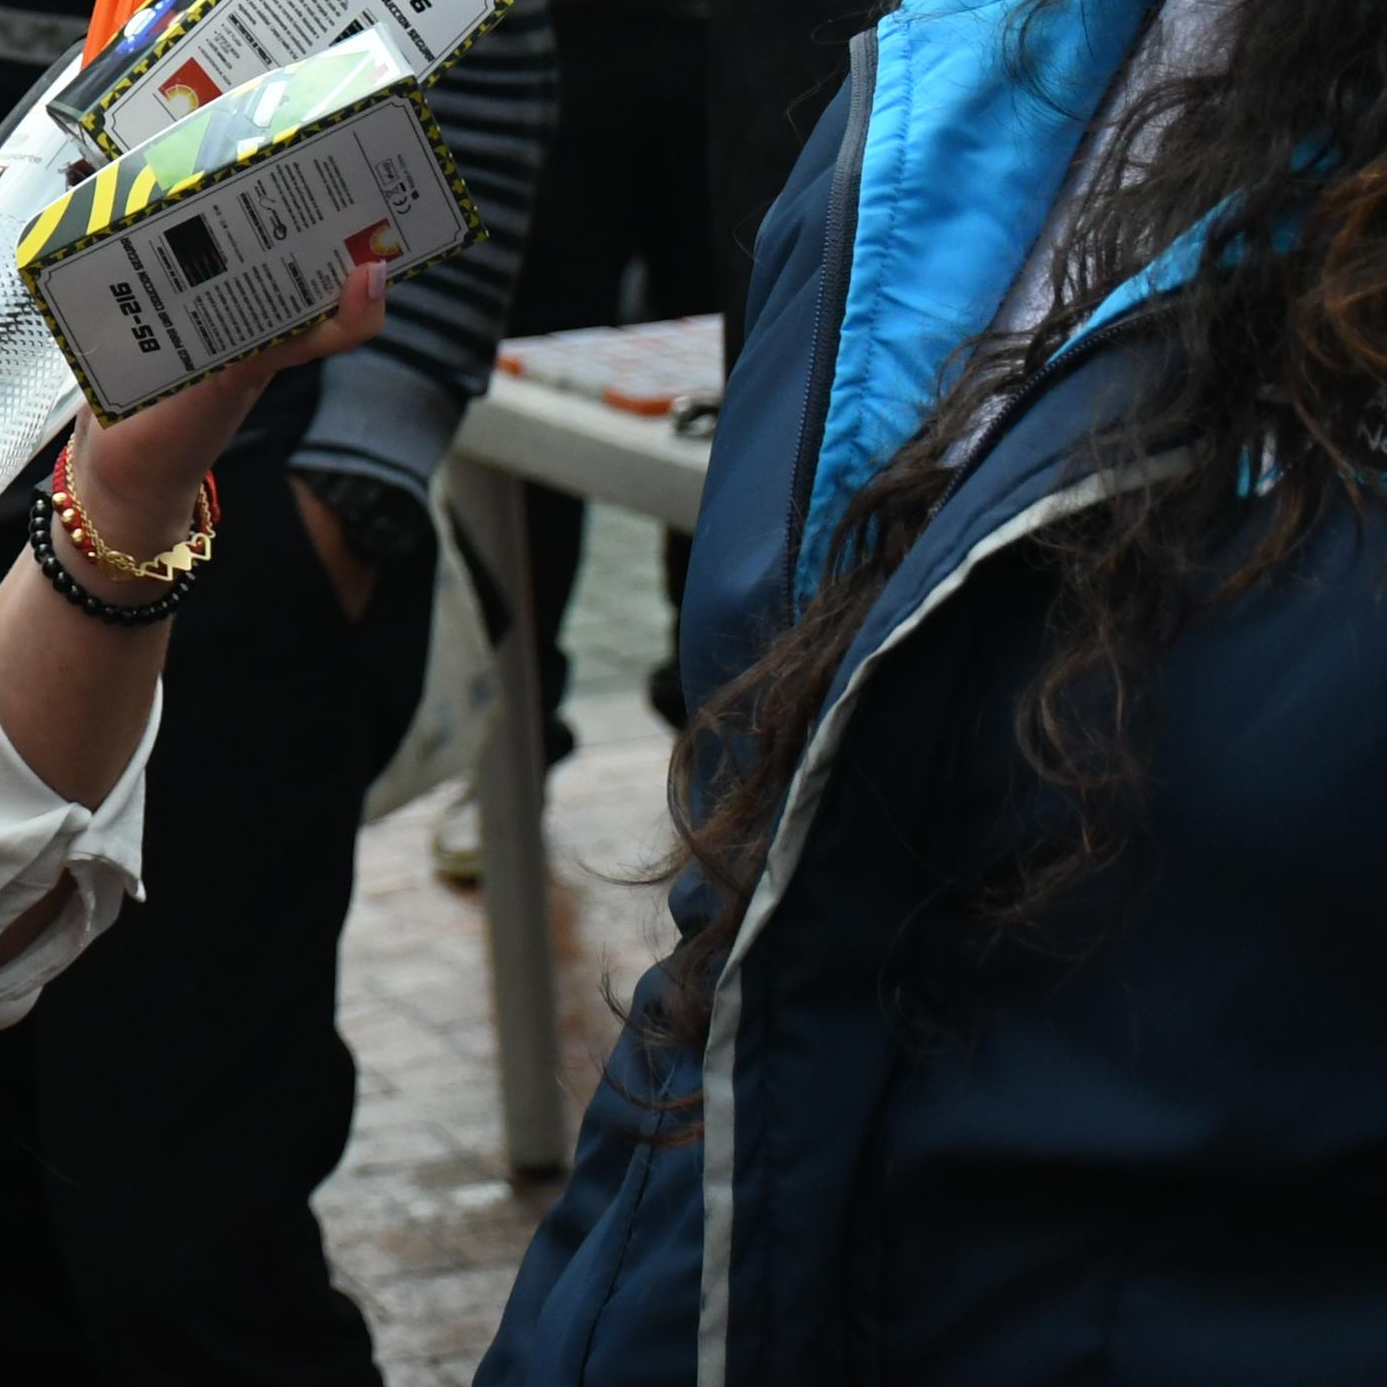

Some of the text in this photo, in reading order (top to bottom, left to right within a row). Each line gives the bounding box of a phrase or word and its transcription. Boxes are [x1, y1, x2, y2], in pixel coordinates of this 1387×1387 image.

[407, 26, 436, 62] SEGURA
[120, 237, 144, 271] SEGURA
[137, 270, 165, 311] CODUCCION
[109, 281, 161, 354] BS-216
[157, 311, 173, 328] UNA
[166, 327, 184, 350] PARA
